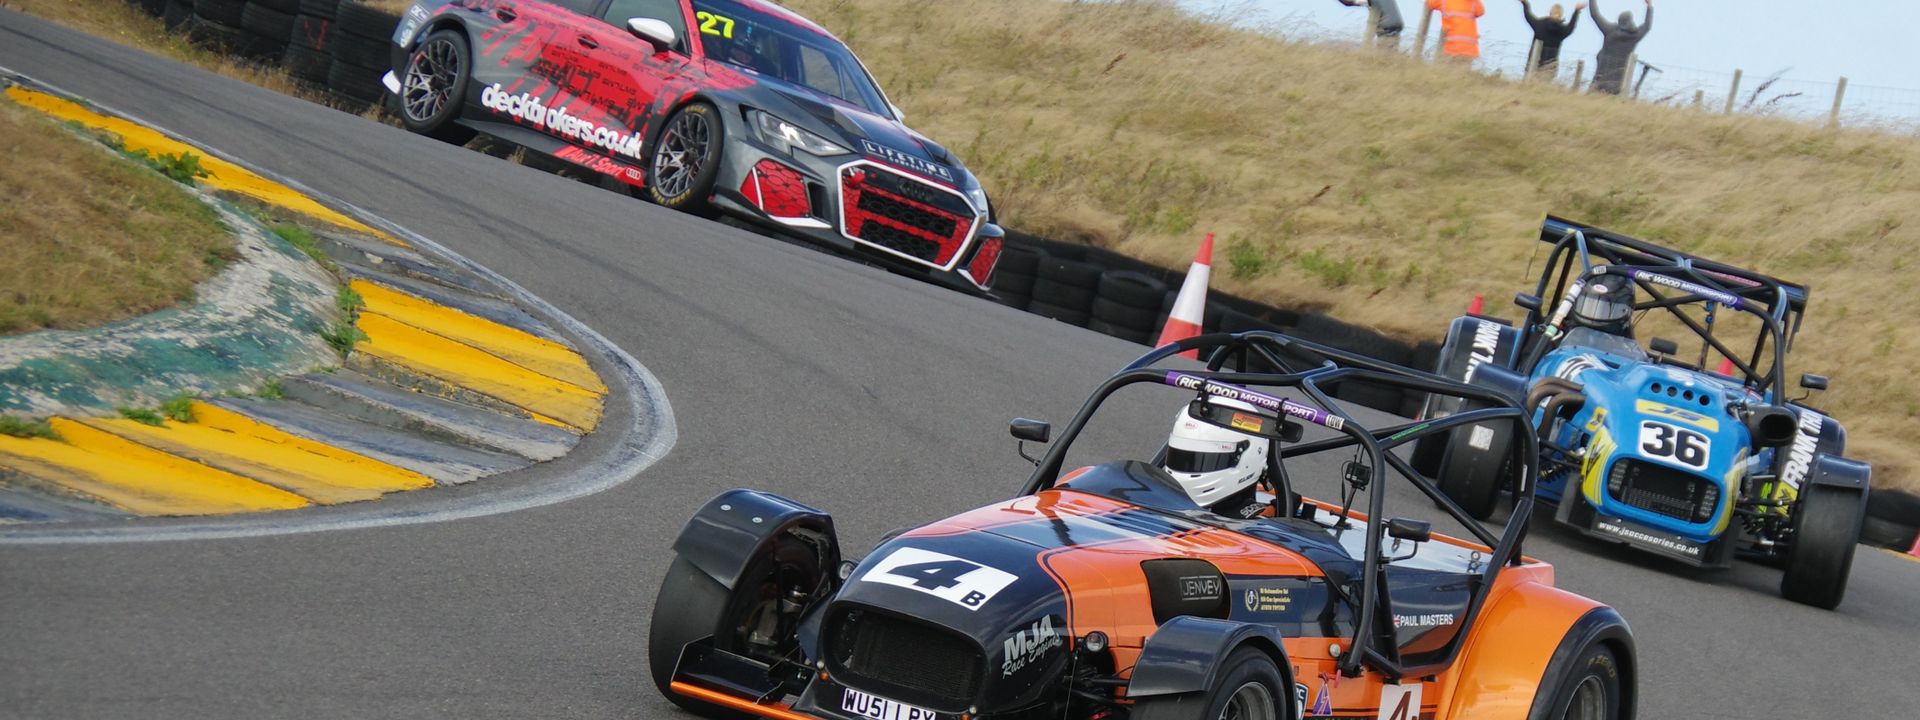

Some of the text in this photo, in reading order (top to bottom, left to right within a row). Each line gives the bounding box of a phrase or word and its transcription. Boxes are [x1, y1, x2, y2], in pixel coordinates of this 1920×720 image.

[696, 11, 735, 39] 27
[481, 83, 643, 160] deckbrokers.co.uk
[866, 142, 948, 177] LIFETIME
[1638, 271, 1653, 281] RIC
[1653, 275, 1681, 288] WOOD
[1179, 376, 1201, 390] RIC
[1240, 392, 1314, 417] MOTORPORT
[1642, 421, 1708, 467] 36
[1782, 428, 1819, 490] FRANK
[886, 559, 986, 608] 4 B
[1183, 580, 1221, 596] JENVEY
[1400, 614, 1454, 626] PAUL MASTERS
[1004, 614, 1056, 663] MJA
[1001, 657, 1026, 680] Race
[844, 689, 888, 720] WU51
